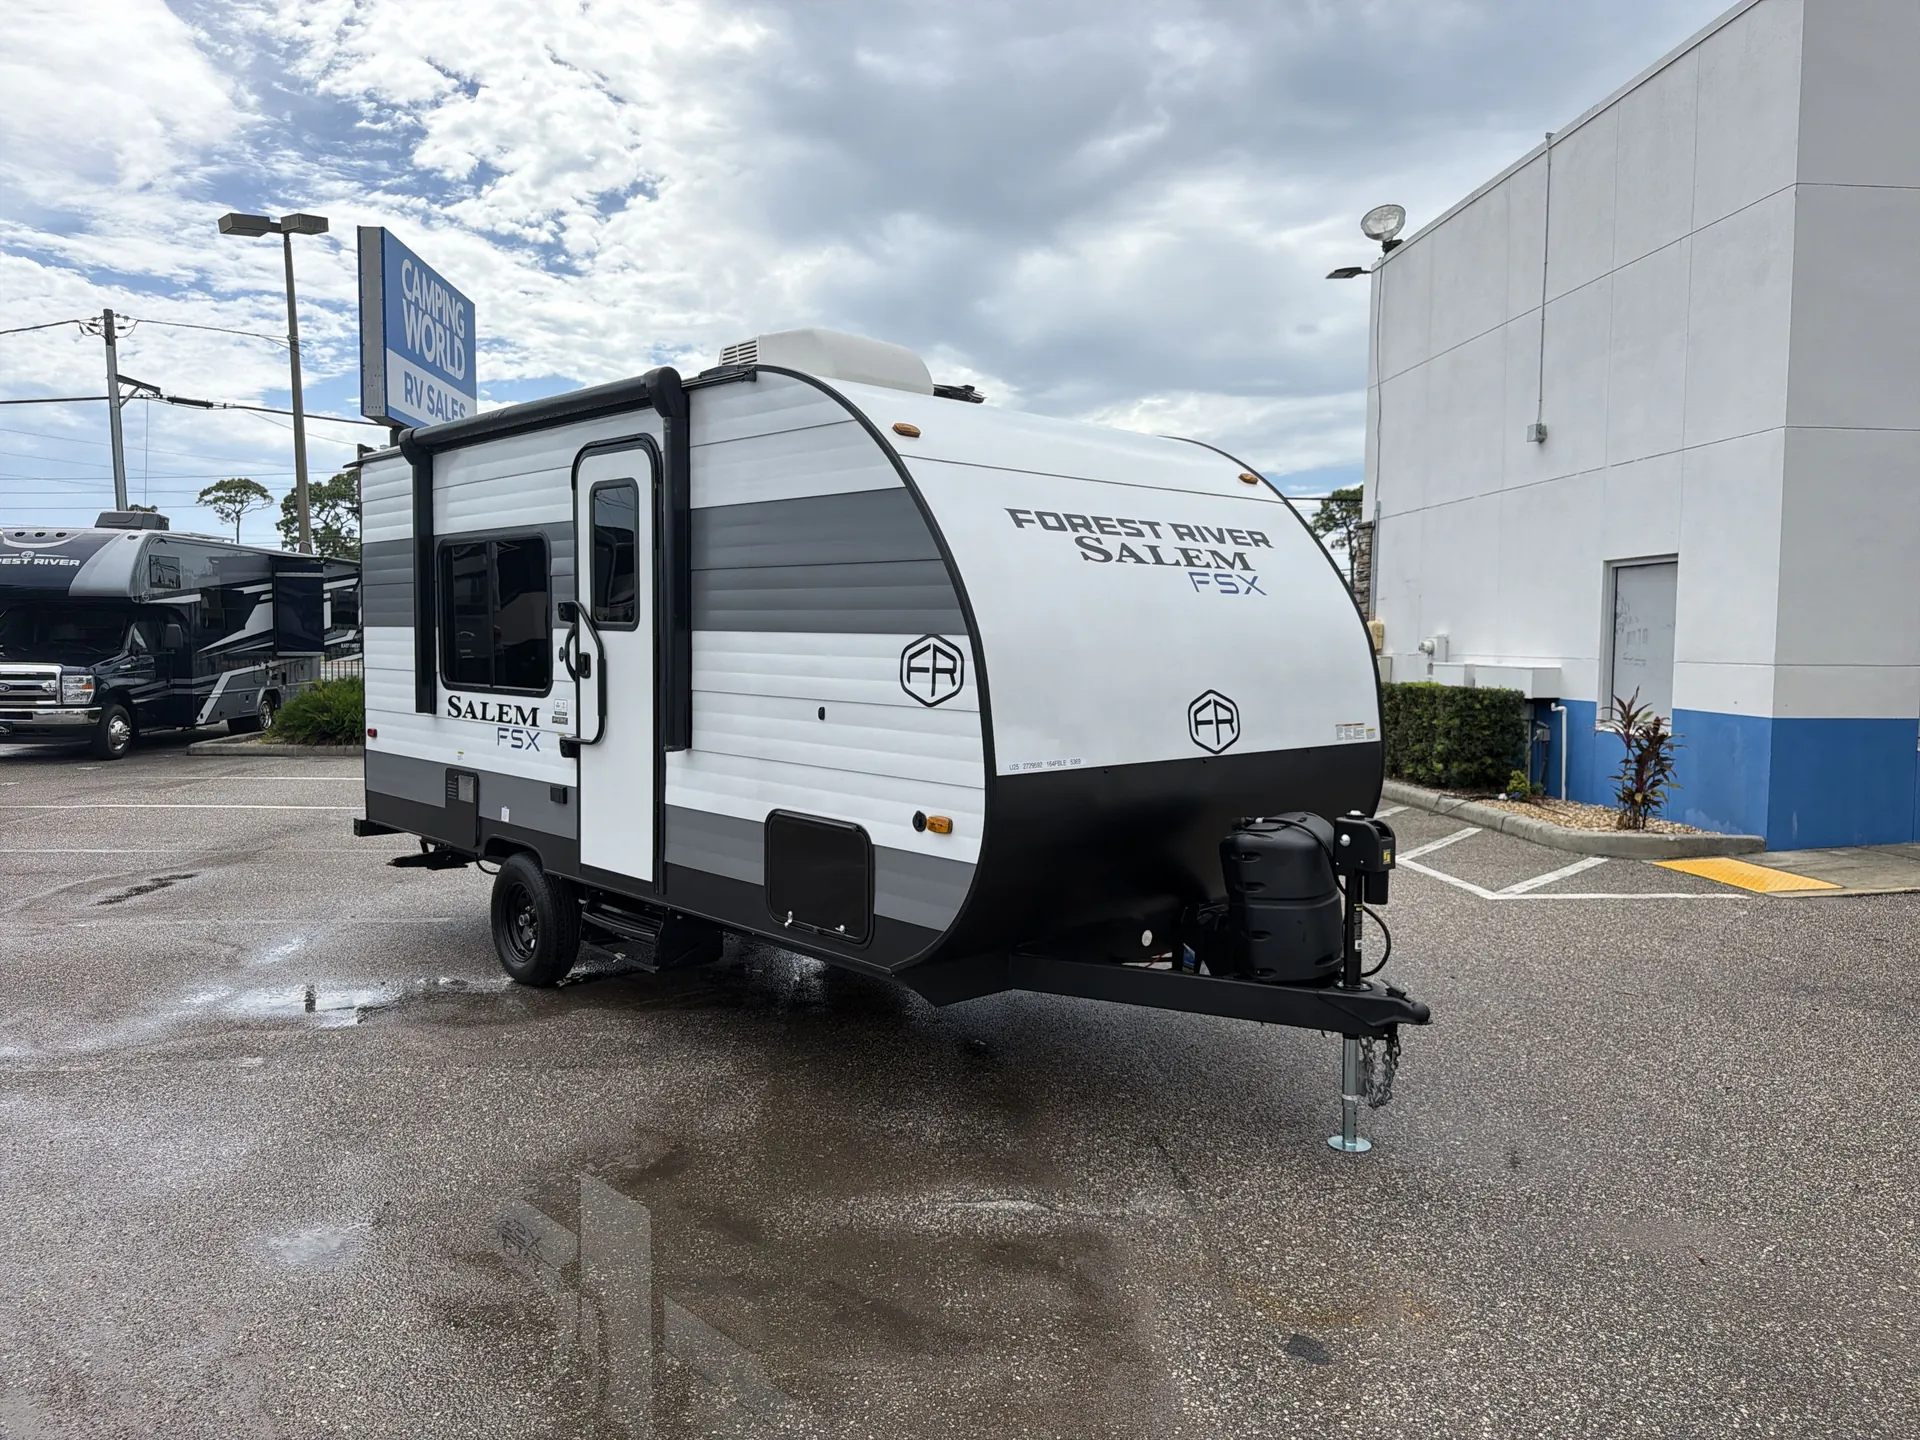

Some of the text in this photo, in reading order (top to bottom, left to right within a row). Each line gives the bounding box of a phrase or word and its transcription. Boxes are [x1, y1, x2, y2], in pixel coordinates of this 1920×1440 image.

[401, 258, 465, 339] CAMPING
[402, 298, 466, 381] WORLD
[404, 370, 466, 421] RV SALES
[1004, 507, 1274, 549] FOREST RIVER
[33, 558, 81, 567] RIVER
[1074, 535, 1256, 571] SALEM
[1188, 571, 1267, 596] FSX
[447, 695, 541, 727] SALEM
[497, 726, 541, 752] FSX
